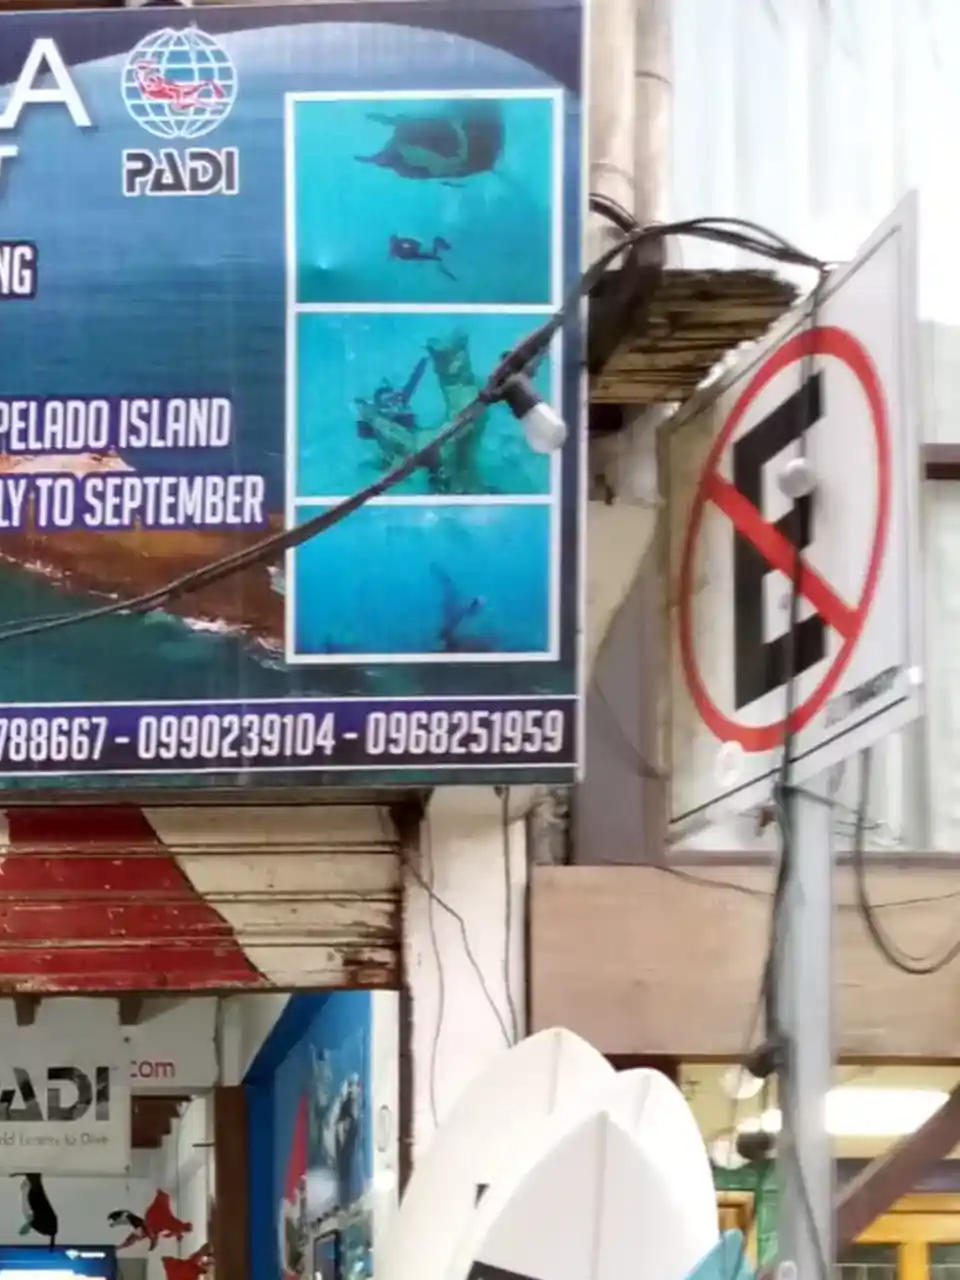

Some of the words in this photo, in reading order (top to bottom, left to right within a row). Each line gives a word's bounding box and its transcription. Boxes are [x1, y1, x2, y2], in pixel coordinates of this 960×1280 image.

[122, 148, 239, 198] PADI
[118, 398, 232, 449] ISLAND
[35, 478, 74, 527] TO
[82, 475, 265, 526] SEPTEMBER
[138, 714, 336, 760] 0990239104
[366, 711, 564, 755] 0968251959
